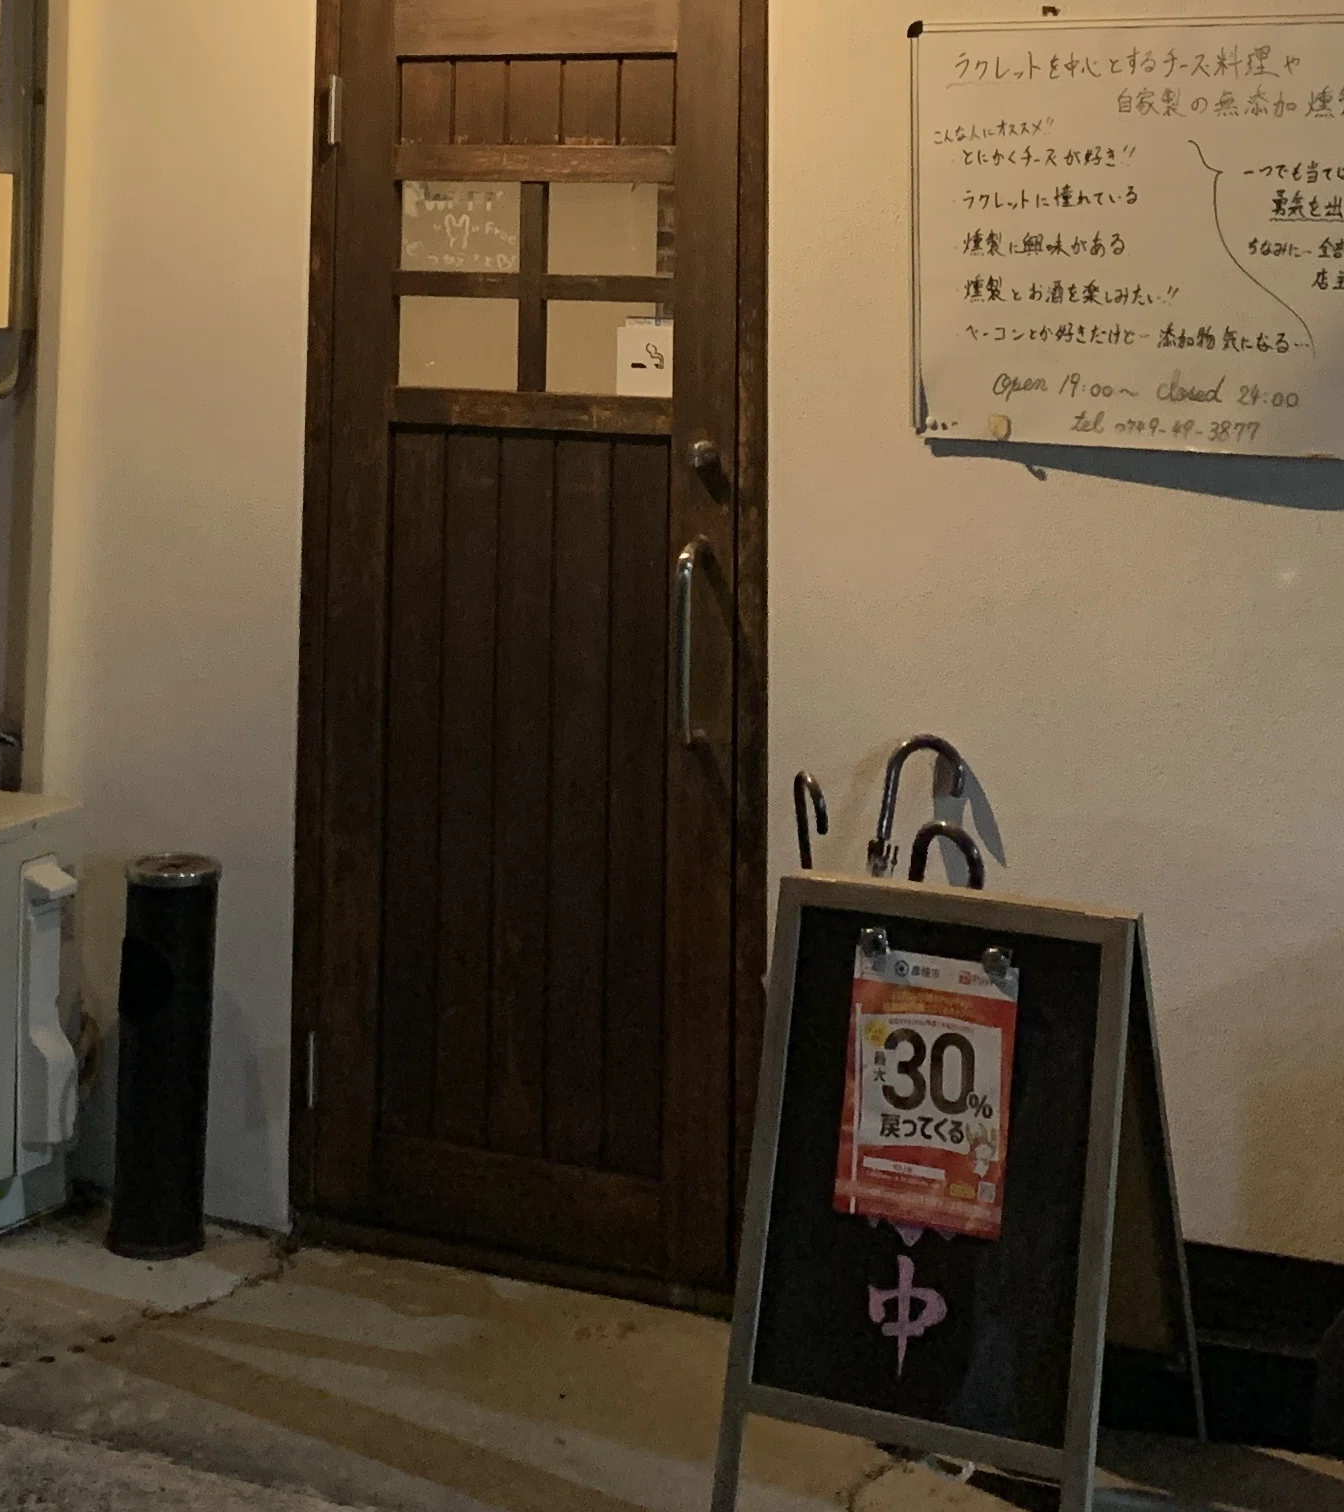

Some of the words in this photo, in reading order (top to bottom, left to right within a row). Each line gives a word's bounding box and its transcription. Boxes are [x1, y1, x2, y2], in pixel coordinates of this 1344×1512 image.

[879, 1112, 965, 1145] 戻ってくる
